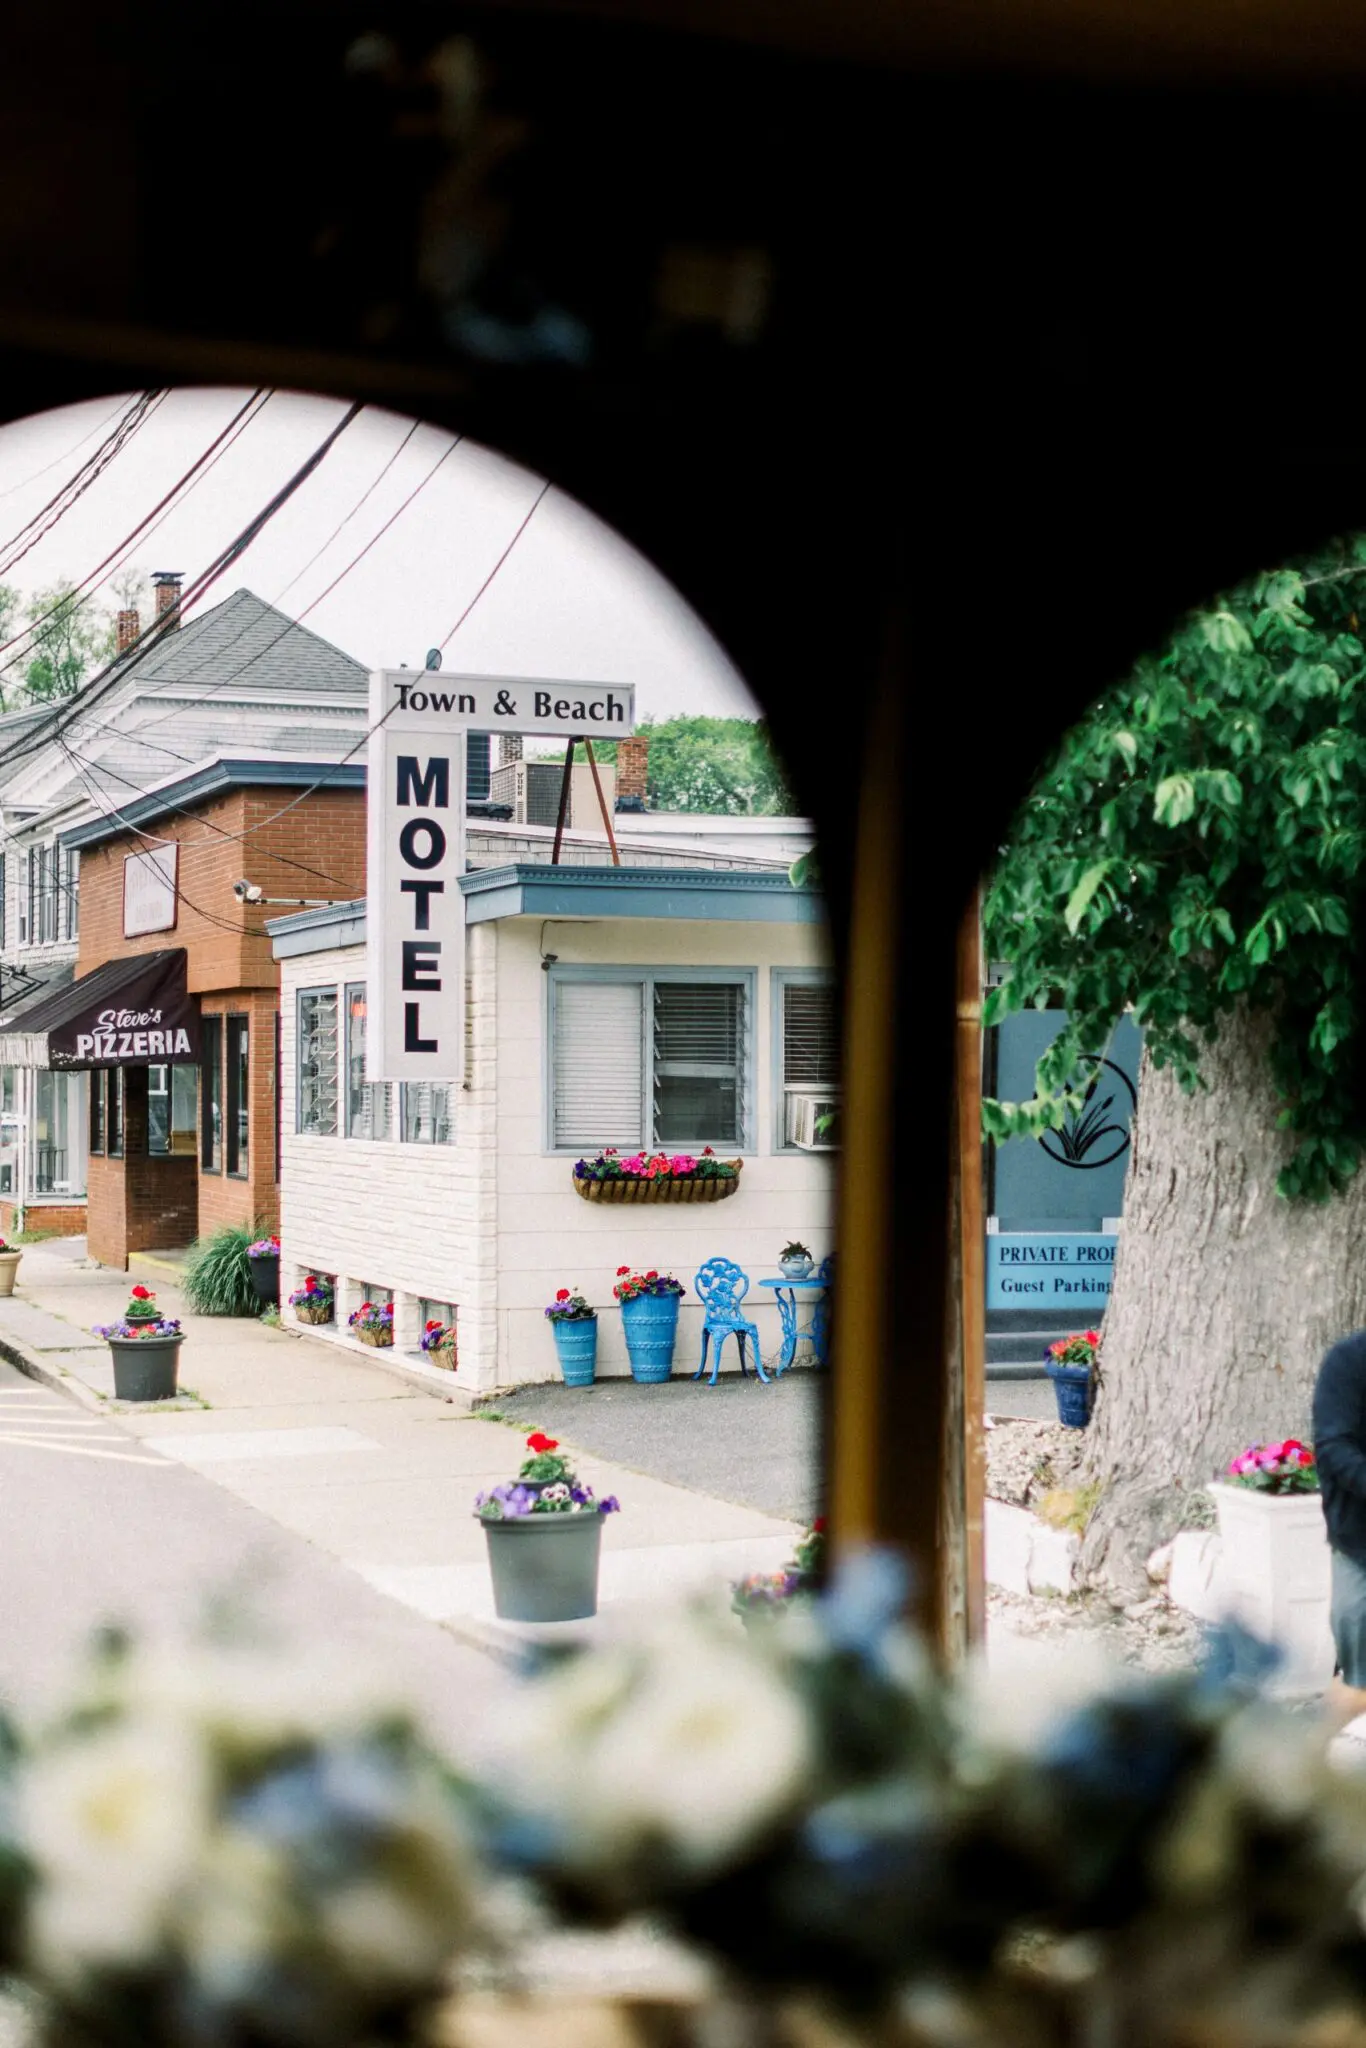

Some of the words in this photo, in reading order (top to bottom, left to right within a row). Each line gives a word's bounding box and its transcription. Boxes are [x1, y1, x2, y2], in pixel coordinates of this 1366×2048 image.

[394, 683, 476, 714] Town
[493, 689, 517, 716] &
[534, 691, 624, 722] Beach
[396, 755, 450, 1053] MOTEL
[92, 1008, 162, 1037] Steve's
[76, 1028, 192, 1060] PIZZERIA
[1000, 1246, 1069, 1262] PRIVATE
[1000, 1278, 1045, 1293] Guest
